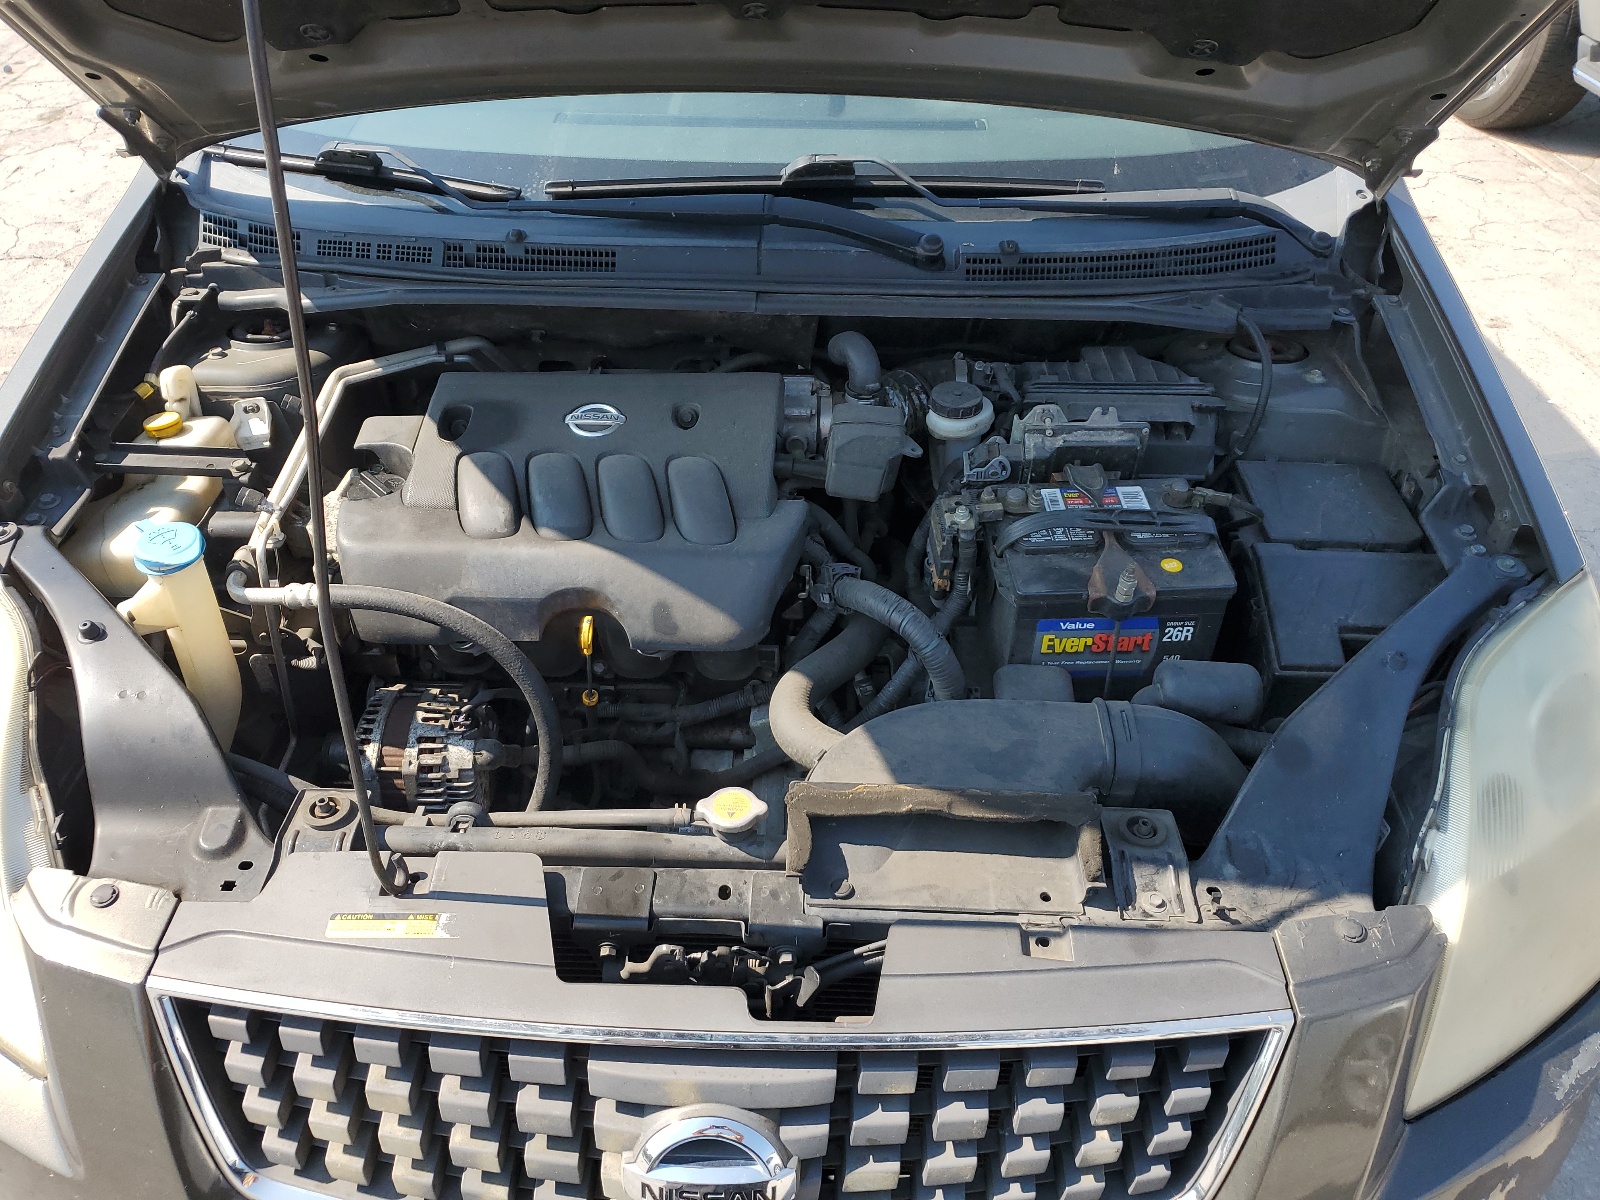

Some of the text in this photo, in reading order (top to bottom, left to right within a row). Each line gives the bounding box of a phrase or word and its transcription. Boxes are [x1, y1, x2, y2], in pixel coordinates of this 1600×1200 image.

[570, 413, 619, 421] NISSAN
[1060, 621, 1095, 630] Value
[1162, 626, 1194, 642] 26R
[1040, 632, 1153, 654] EverStart
[641, 1181, 777, 1200] NISSAN
